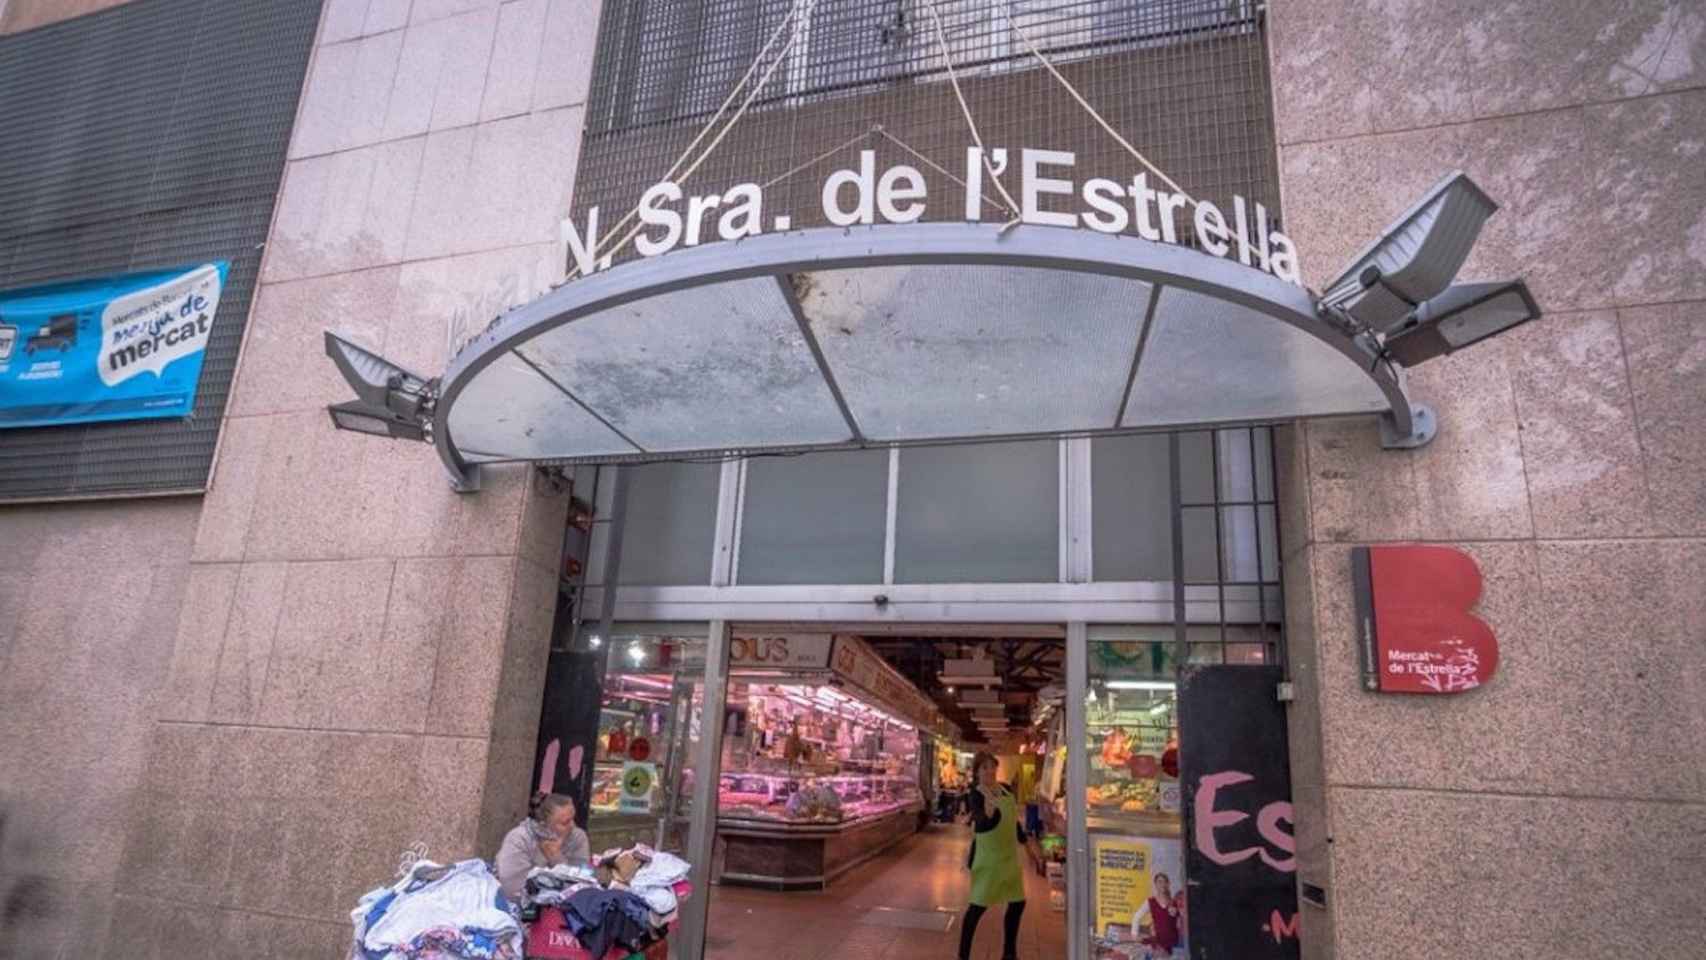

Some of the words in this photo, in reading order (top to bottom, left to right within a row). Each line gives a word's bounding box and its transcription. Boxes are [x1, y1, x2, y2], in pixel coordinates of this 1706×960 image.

[634, 181, 791, 257] Sra.
[822, 150, 928, 226] de
[965, 146, 1301, 287] l'Estrella
[180, 294, 209, 318] de
[110, 313, 209, 370] mercat
[1388, 650, 1430, 661] Mercat
[1389, 663, 1405, 674] de
